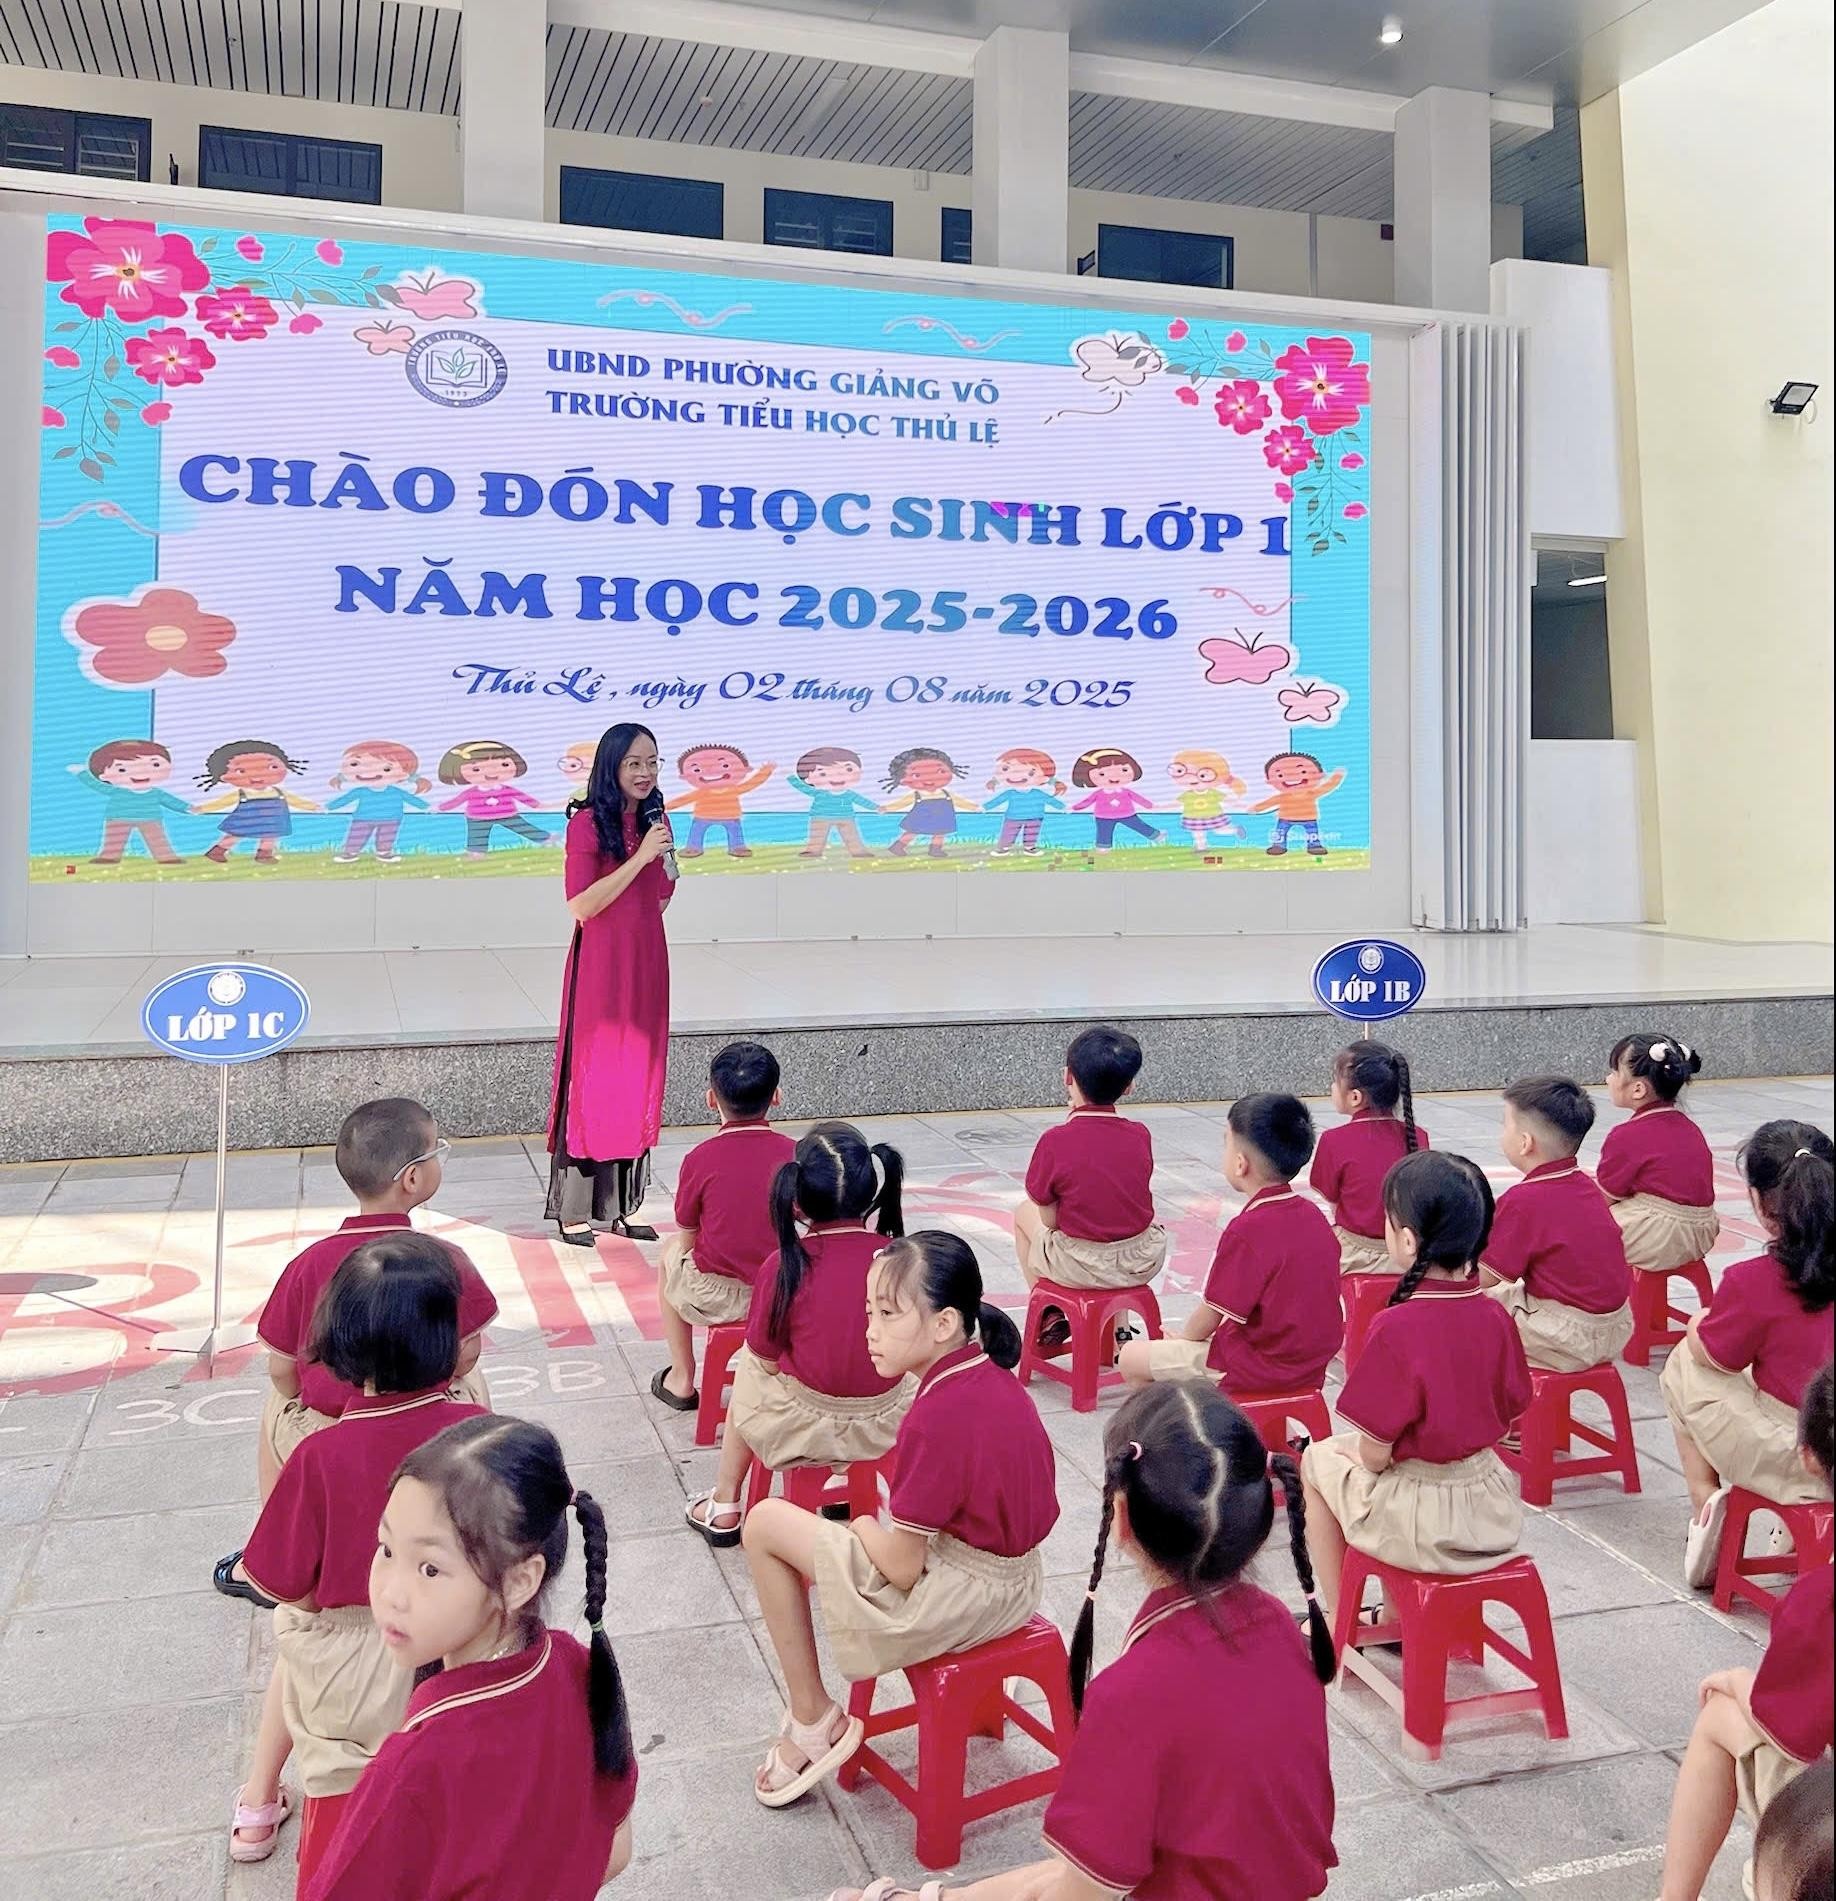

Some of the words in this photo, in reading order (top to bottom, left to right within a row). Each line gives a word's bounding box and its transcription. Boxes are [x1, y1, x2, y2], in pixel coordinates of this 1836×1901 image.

[548, 349, 650, 377] UBND
[664, 358, 817, 391] PHƯỜNG
[830, 369, 940, 400] GIẢNG
[952, 379, 999, 404] VÕ
[545, 391, 705, 423] TRƯỜNG
[718, 397, 792, 429] TIỂU
[806, 410, 879, 438] HỌC
[891, 413, 956, 441] THỦ
[970, 418, 1000, 448] LỆ
[178, 452, 455, 514] CHÀO
[478, 467, 674, 526] ĐÓN
[696, 485, 871, 545] HỌC
[890, 497, 1081, 546] SINH
[1101, 501, 1243, 553] LỚP
[1259, 515, 1290, 556] 1
[334, 556, 553, 619] NĂM
[576, 576, 759, 636] HỌC
[779, 585, 1178, 640] 2025-2026
[453, 664, 536, 694] Thủ
[626, 676, 708, 709] ngày
[719, 672, 785, 701] 02
[791, 679, 874, 712] tháng
[886, 676, 947, 703] 08
[952, 684, 1012, 703] năm
[1020, 679, 1136, 708] 2025
[1330, 974, 1377, 1003] LỚP
[1383, 980, 1411, 1003] 1B
[167, 1006, 237, 1042] LỚP
[247, 1012, 285, 1039] 1C
[108, 1390, 260, 1435] 3C
